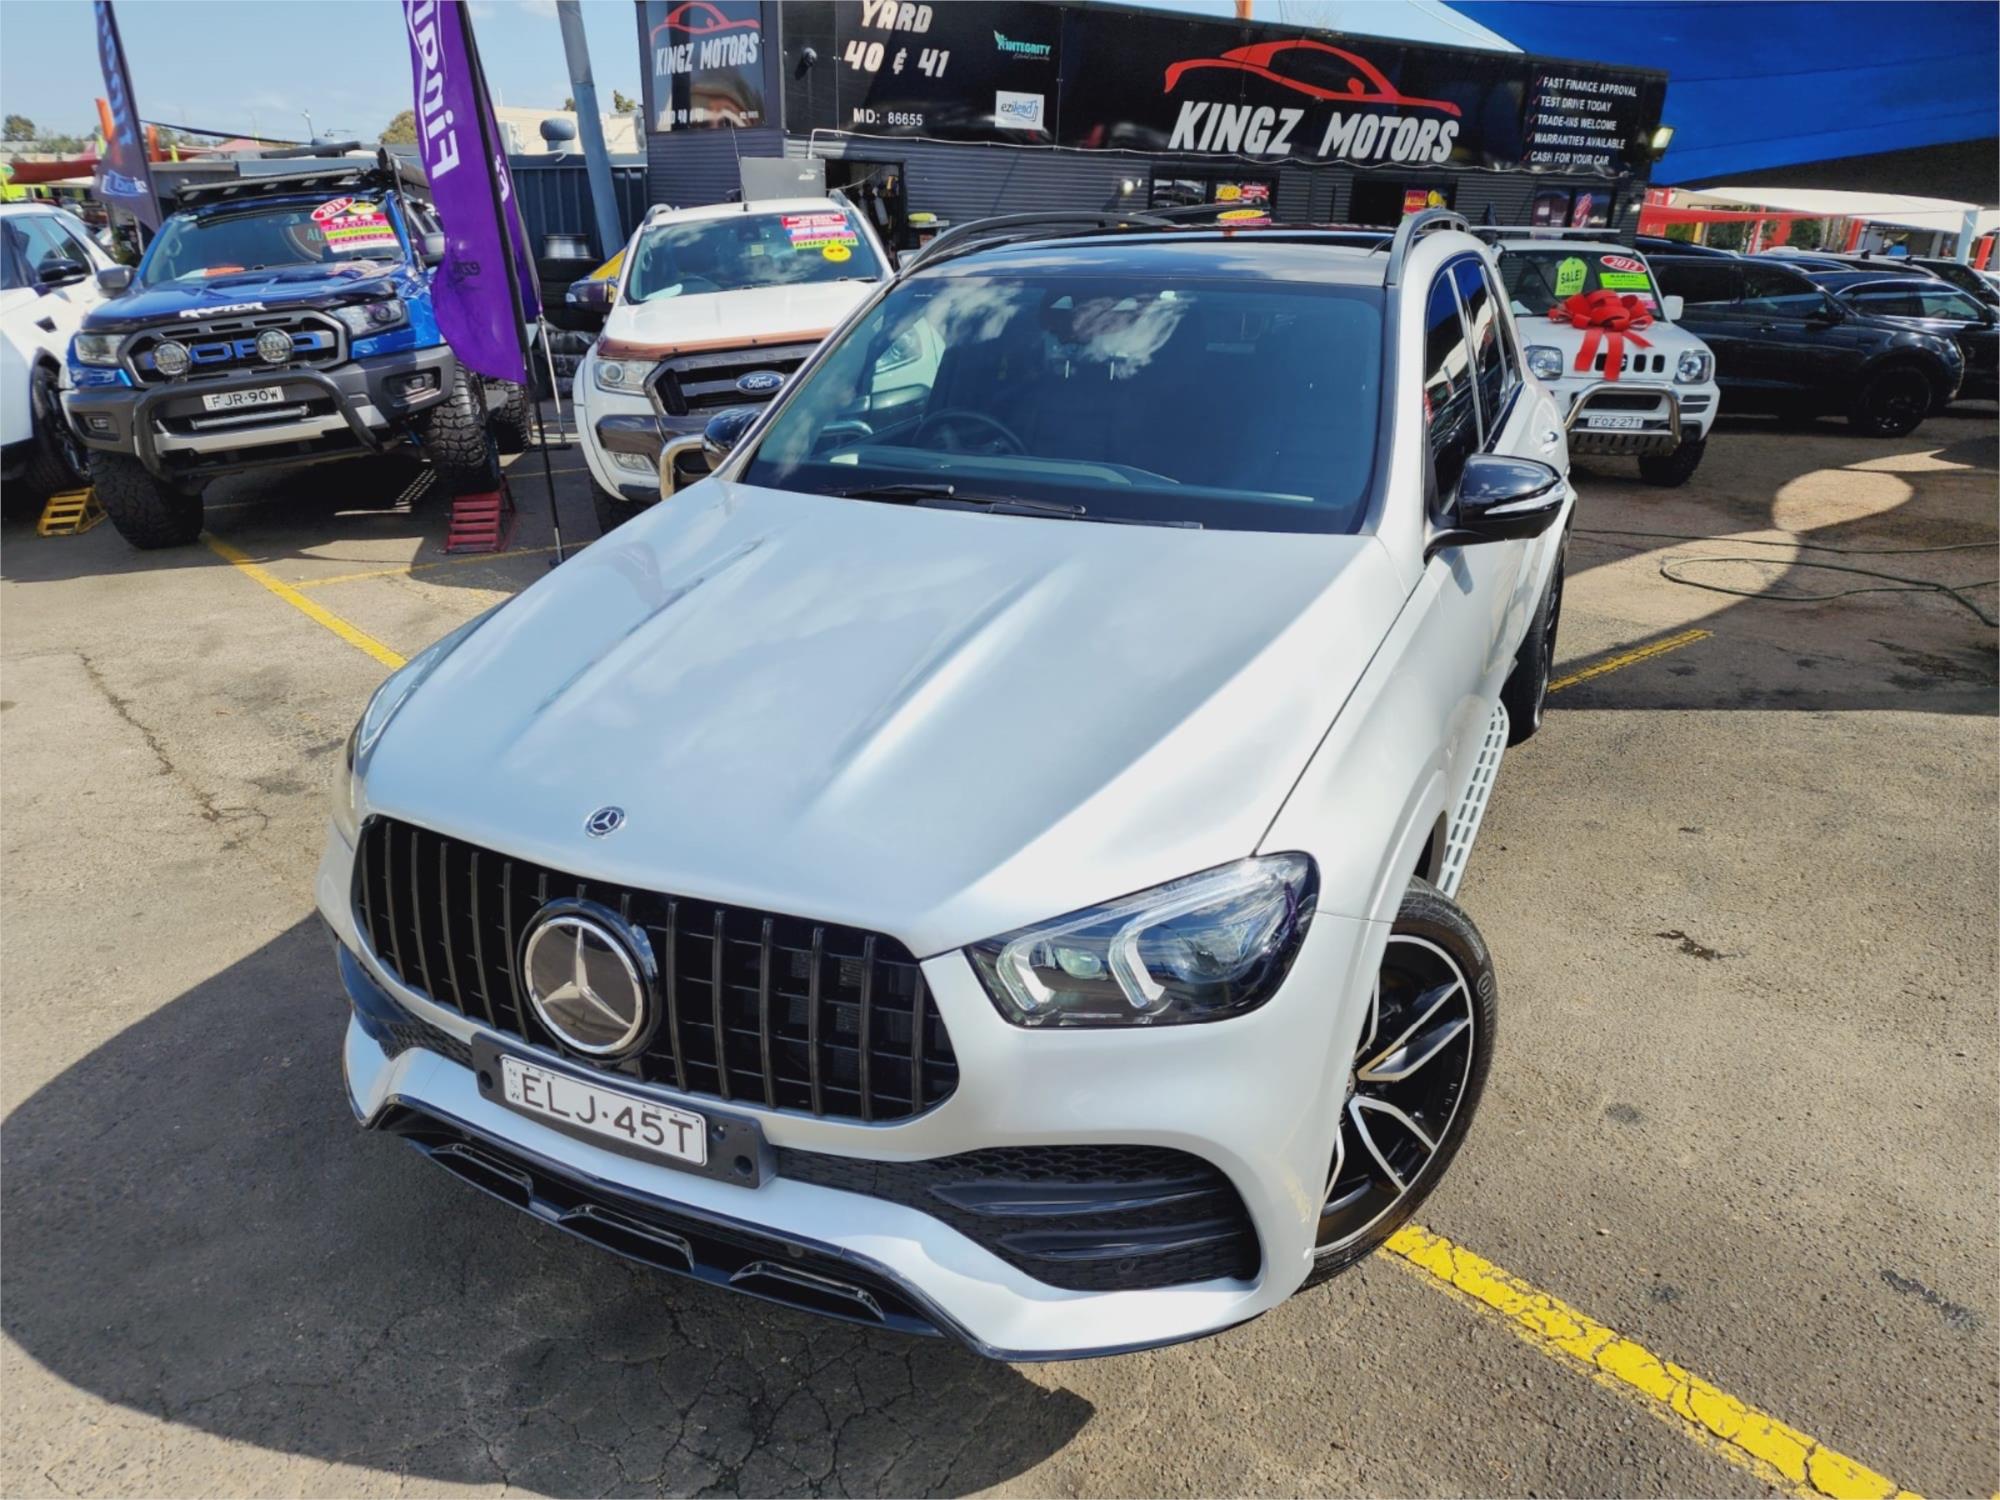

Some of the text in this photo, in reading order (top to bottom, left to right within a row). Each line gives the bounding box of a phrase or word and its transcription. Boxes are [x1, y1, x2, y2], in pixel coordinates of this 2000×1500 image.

[860, 0, 934, 34] YARD
[655, 32, 760, 76] KINGZ MOTORS
[1005, 40, 1052, 56] INTEGRITY
[844, 40, 884, 73] 40
[918, 50, 950, 78] 41
[1543, 76, 1637, 97] FAST FINANCE APPROVAL
[1540, 96, 1612, 112] TEST DRIVE TODAY
[853, 108, 924, 127] MD: 86655
[1537, 114, 1617, 131] TRADE-INS WELCOME
[1167, 101, 1460, 164] KINGZ MOTORS
[1534, 133, 1626, 149] WARRANTIES AVAILABLE
[1530, 151, 1610, 166] CASH FOR YOUR CAR
[179, 302, 267, 318] RAPTOR
[747, 375, 774, 389] Ford
